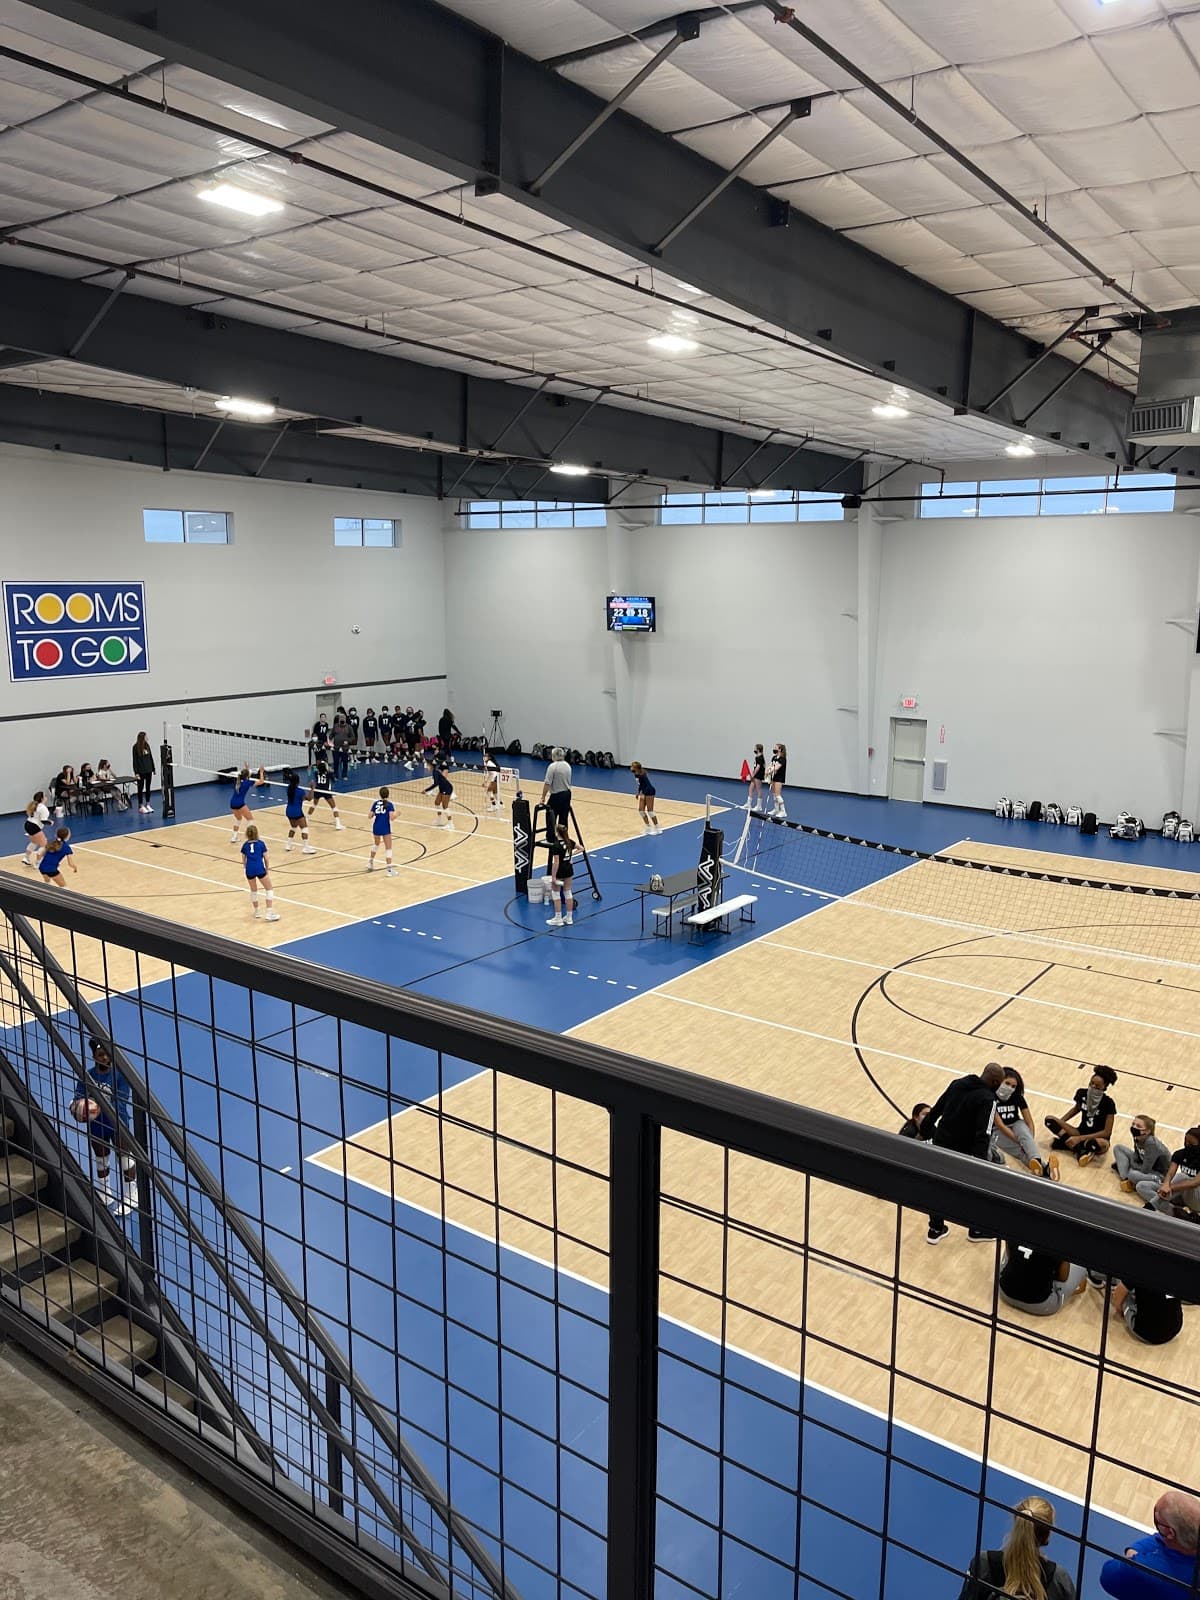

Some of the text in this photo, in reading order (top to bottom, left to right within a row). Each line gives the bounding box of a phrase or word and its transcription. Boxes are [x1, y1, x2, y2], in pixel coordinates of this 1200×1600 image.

[12, 591, 141, 625] ROOMS
[16, 635, 128, 670] TO GO
